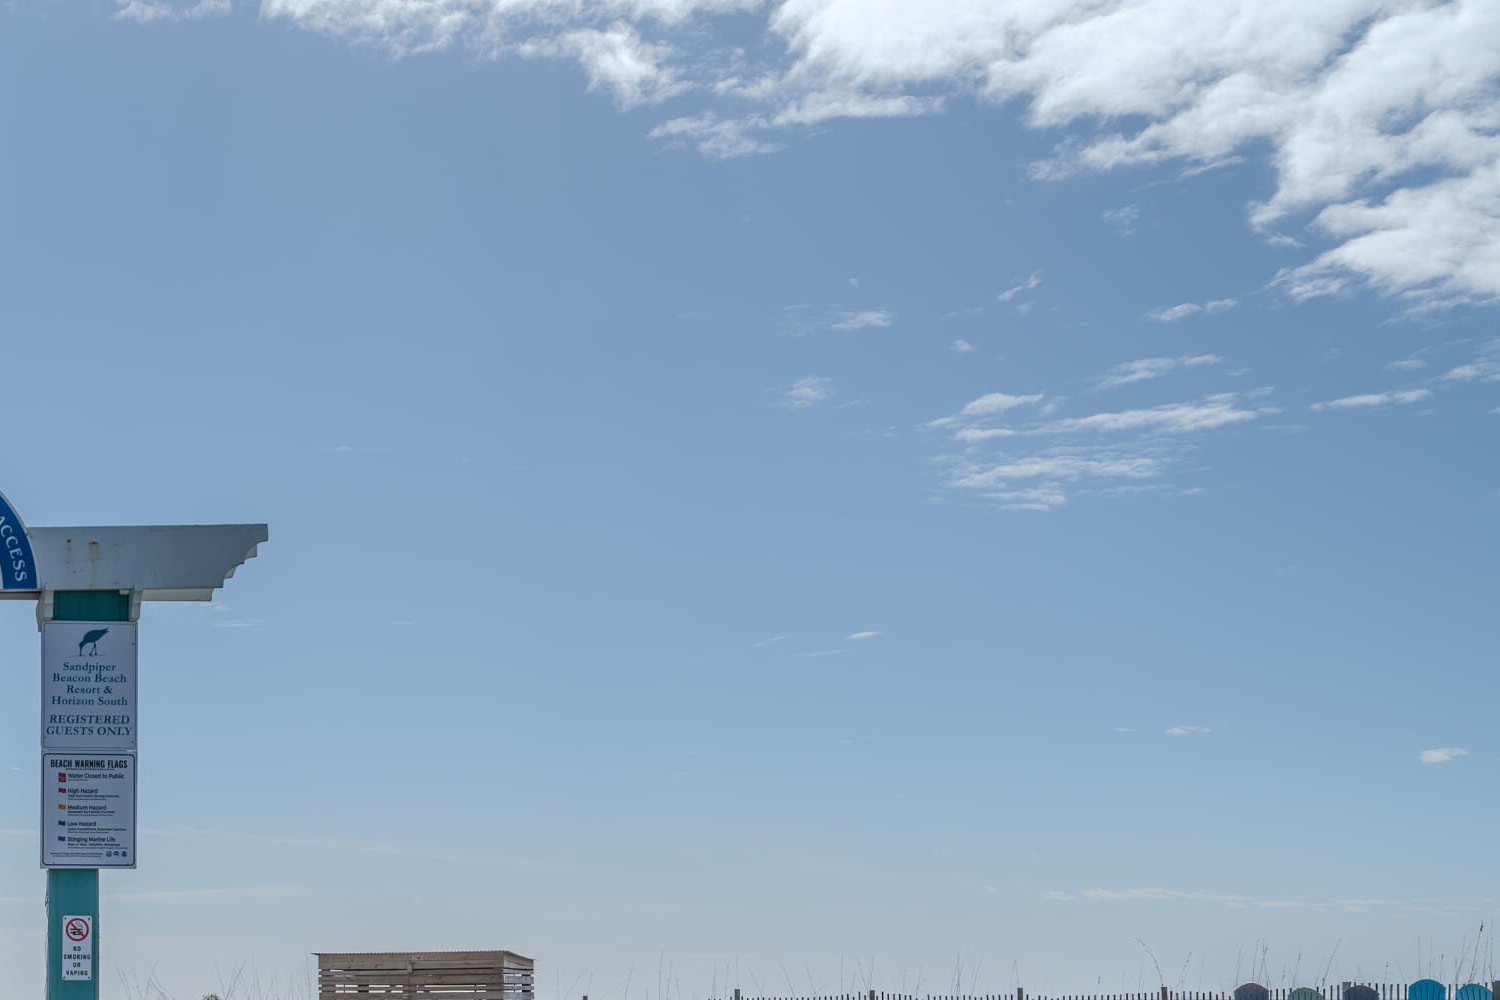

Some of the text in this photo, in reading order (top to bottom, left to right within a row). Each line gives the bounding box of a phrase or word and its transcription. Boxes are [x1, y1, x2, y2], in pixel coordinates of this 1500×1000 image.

[62, 661, 117, 674] Sandpiper
[52, 672, 127, 684] Beacon Beach
[66, 684, 113, 695] Resort &
[51, 695, 128, 706] Horizon South
[49, 714, 131, 725] REGISTERED
[46, 725, 133, 737] GUESTS ONLY
[50, 759, 128, 769] BEACH WARNING FLAGS
